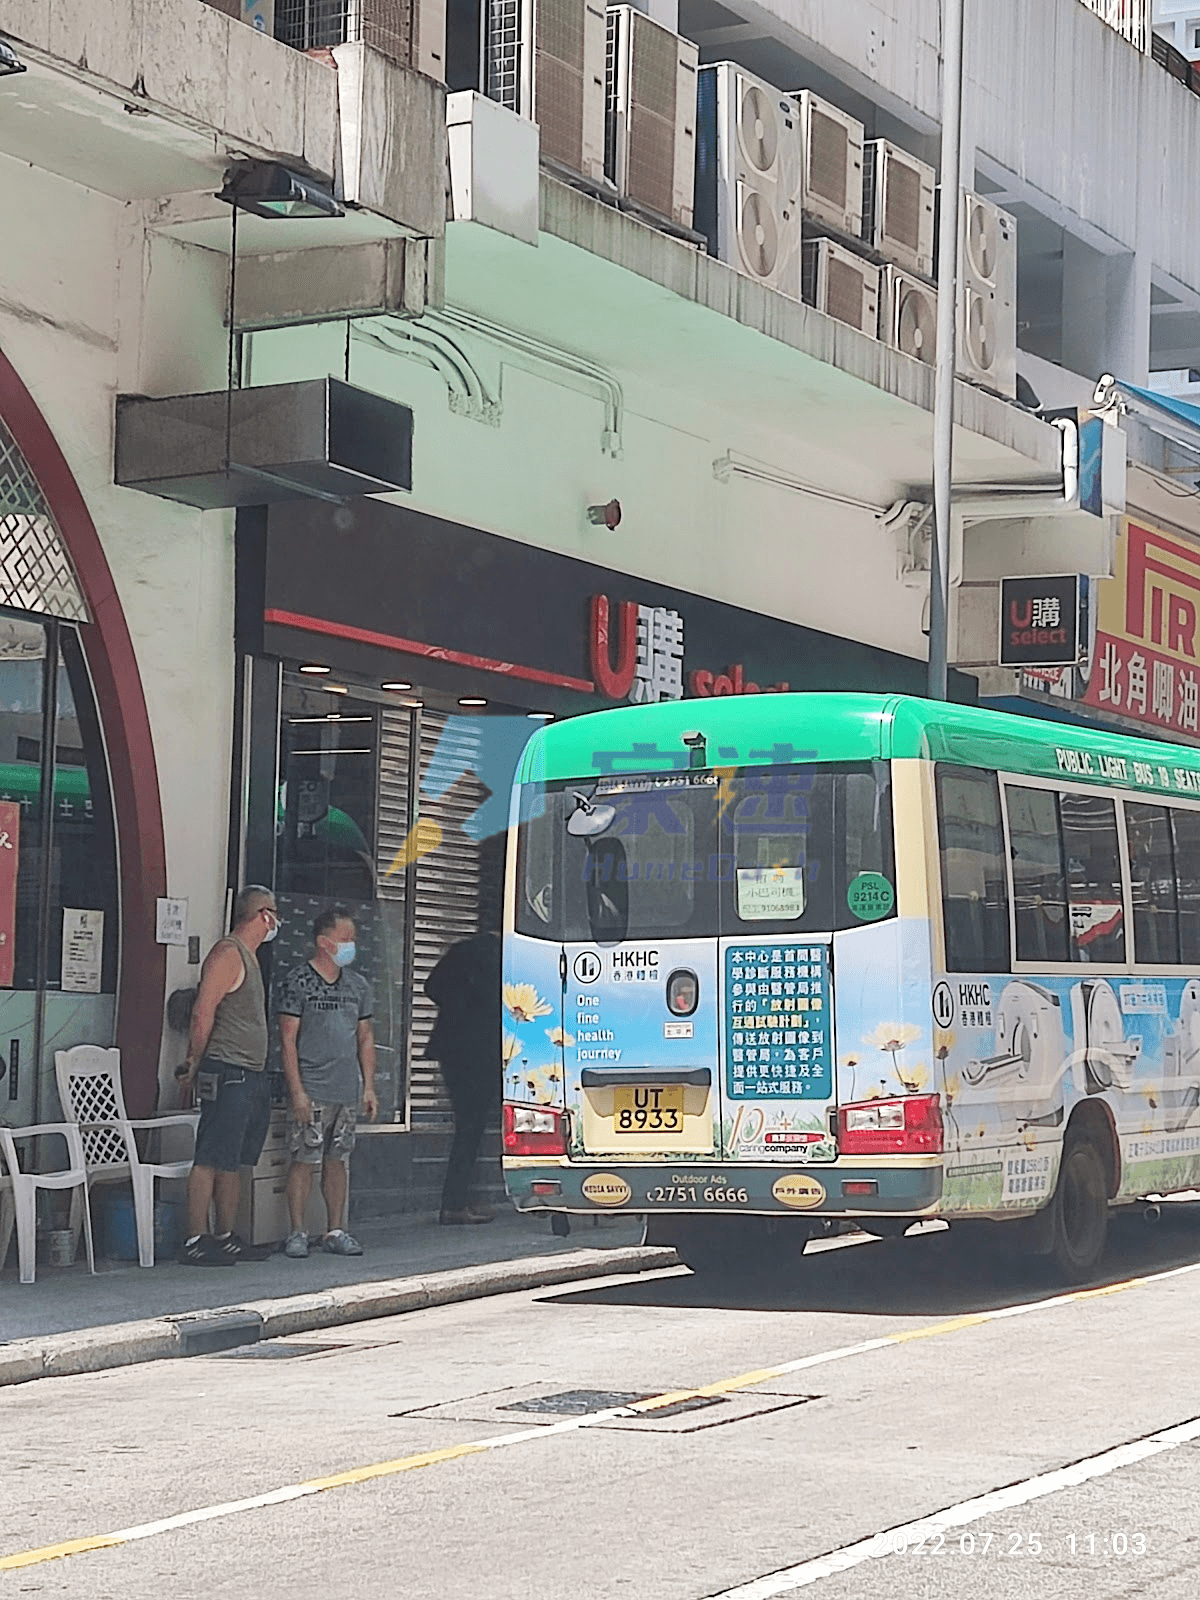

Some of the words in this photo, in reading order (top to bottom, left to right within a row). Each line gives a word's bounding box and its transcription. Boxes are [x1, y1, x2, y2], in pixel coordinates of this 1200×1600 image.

[1010, 597, 1060, 629] U購
[1010, 628, 1067, 645] select
[1055, 748, 1094, 775] PUBLIC
[1097, 755, 1128, 781] LIGHT
[1132, 761, 1154, 785] BUS
[861, 881, 879, 890] PSL
[612, 950, 659, 967] HKHC
[576, 994, 600, 1007] One
[959, 984, 990, 1006] HKHC
[576, 1011, 600, 1024] fine
[576, 1029, 615, 1042] health
[576, 1047, 622, 1062] journey
[733, 1064, 824, 1078] 提供更快捷及全
[634, 1088, 664, 1108] UT
[619, 1109, 679, 1129] 8933
[672, 1174, 708, 1184] Outdoor
[710, 1174, 727, 1184] Ads
[653, 1187, 698, 1202] 2751
[703, 1187, 749, 1203] 6666
